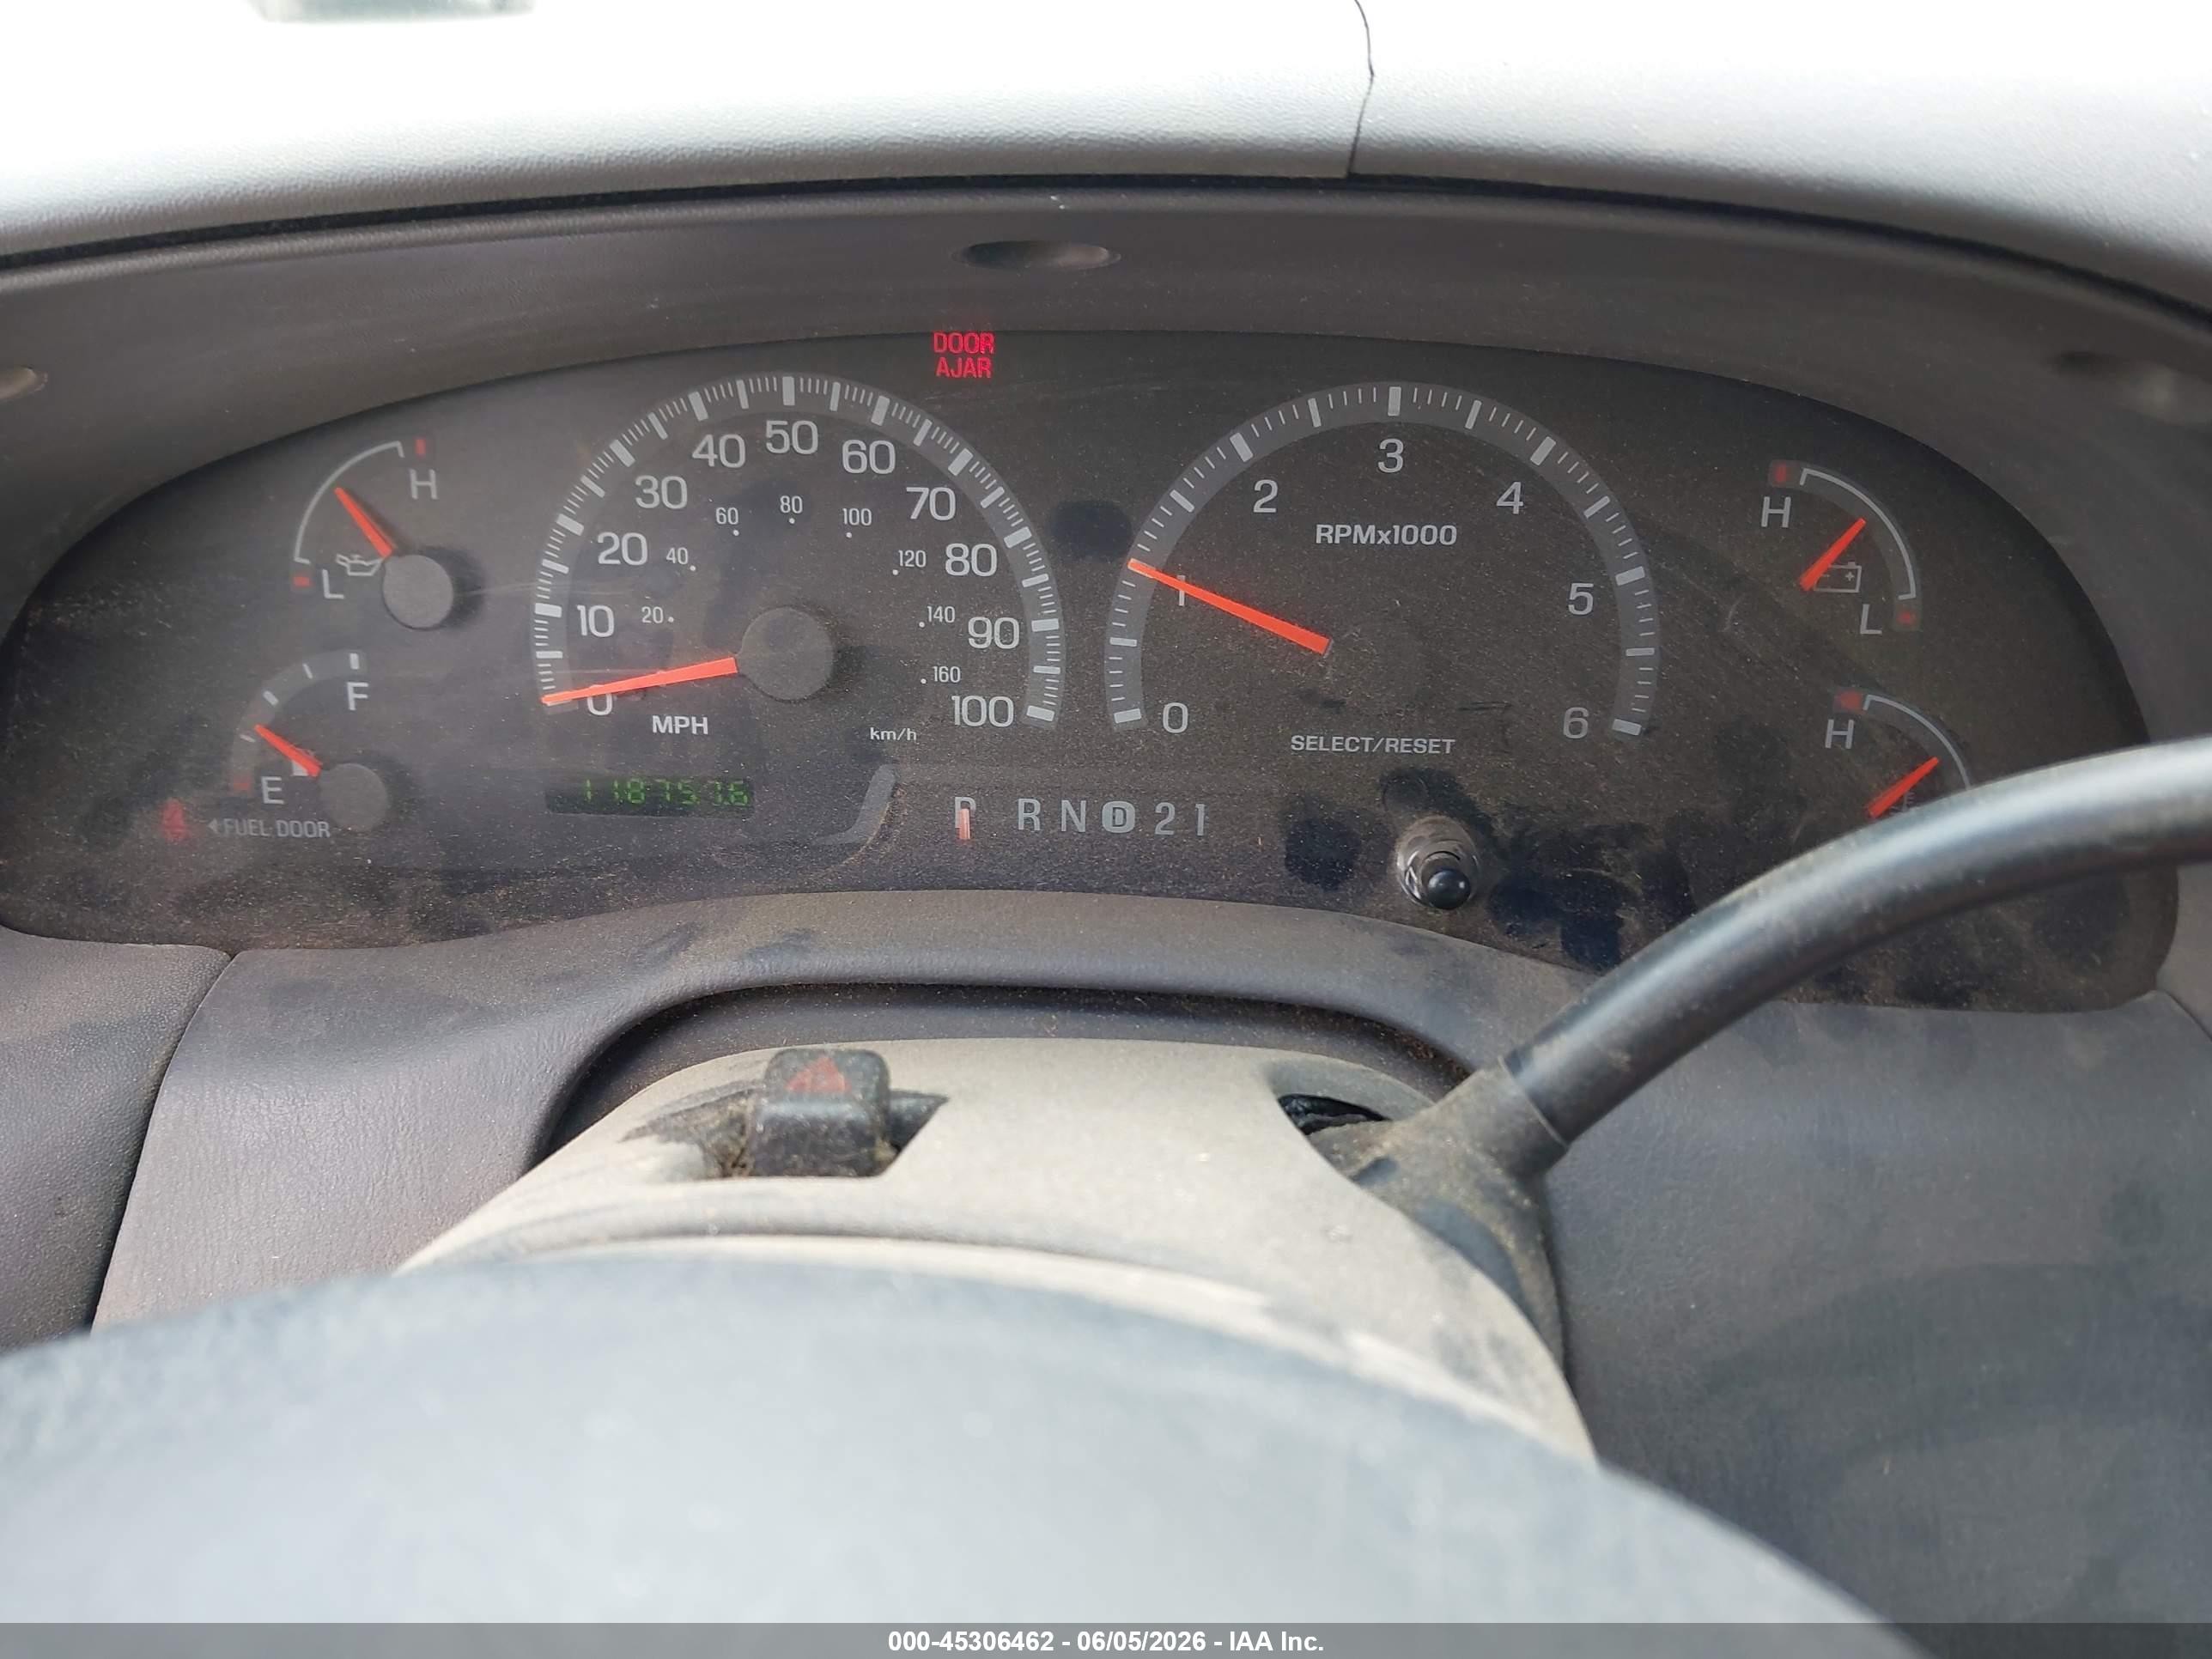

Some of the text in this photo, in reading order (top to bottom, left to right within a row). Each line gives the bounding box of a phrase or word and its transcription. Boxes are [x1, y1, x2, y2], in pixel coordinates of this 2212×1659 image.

[933, 331, 995, 354] DOOR
[935, 358, 992, 378] AJAR
[691, 434, 746, 469] 40
[764, 421, 819, 454] 50
[842, 441, 896, 474] 60
[1377, 438, 1404, 472] 3
[410, 469, 437, 500] H
[635, 476, 688, 509] 30
[1252, 480, 1279, 513] 2
[1496, 482, 1523, 514] 4
[715, 507, 738, 526] 60
[780, 496, 803, 514] 80
[842, 508, 872, 526] 100
[906, 487, 957, 520] 70
[1760, 496, 1791, 528] H
[598, 532, 648, 566] 20
[1315, 524, 1457, 545] RPMx1000
[665, 547, 689, 565] 40
[898, 550, 927, 568] 120
[945, 544, 998, 576] 80
[321, 569, 343, 599] L
[1567, 582, 1595, 615] 5
[576, 605, 615, 638] 10
[641, 607, 664, 624] 20
[927, 606, 956, 623] 140
[1860, 604, 1882, 635] L
[967, 617, 1020, 649] 90
[933, 665, 961, 683] 160
[346, 682, 368, 710] F
[951, 695, 1014, 727] 100
[652, 715, 708, 735] MPH
[1163, 702, 1189, 733] 0
[1562, 707, 1589, 739] 6
[870, 726, 917, 742] km/h
[1291, 733, 1455, 755] SELECT/RESET
[1825, 719, 1854, 749] H
[261, 776, 284, 805] E
[223, 818, 331, 837] FUEL DOOR
[1018, 798, 1041, 830] R
[1060, 800, 1086, 832] N
[1154, 802, 1176, 835] 2
[1195, 804, 1206, 836] 1
